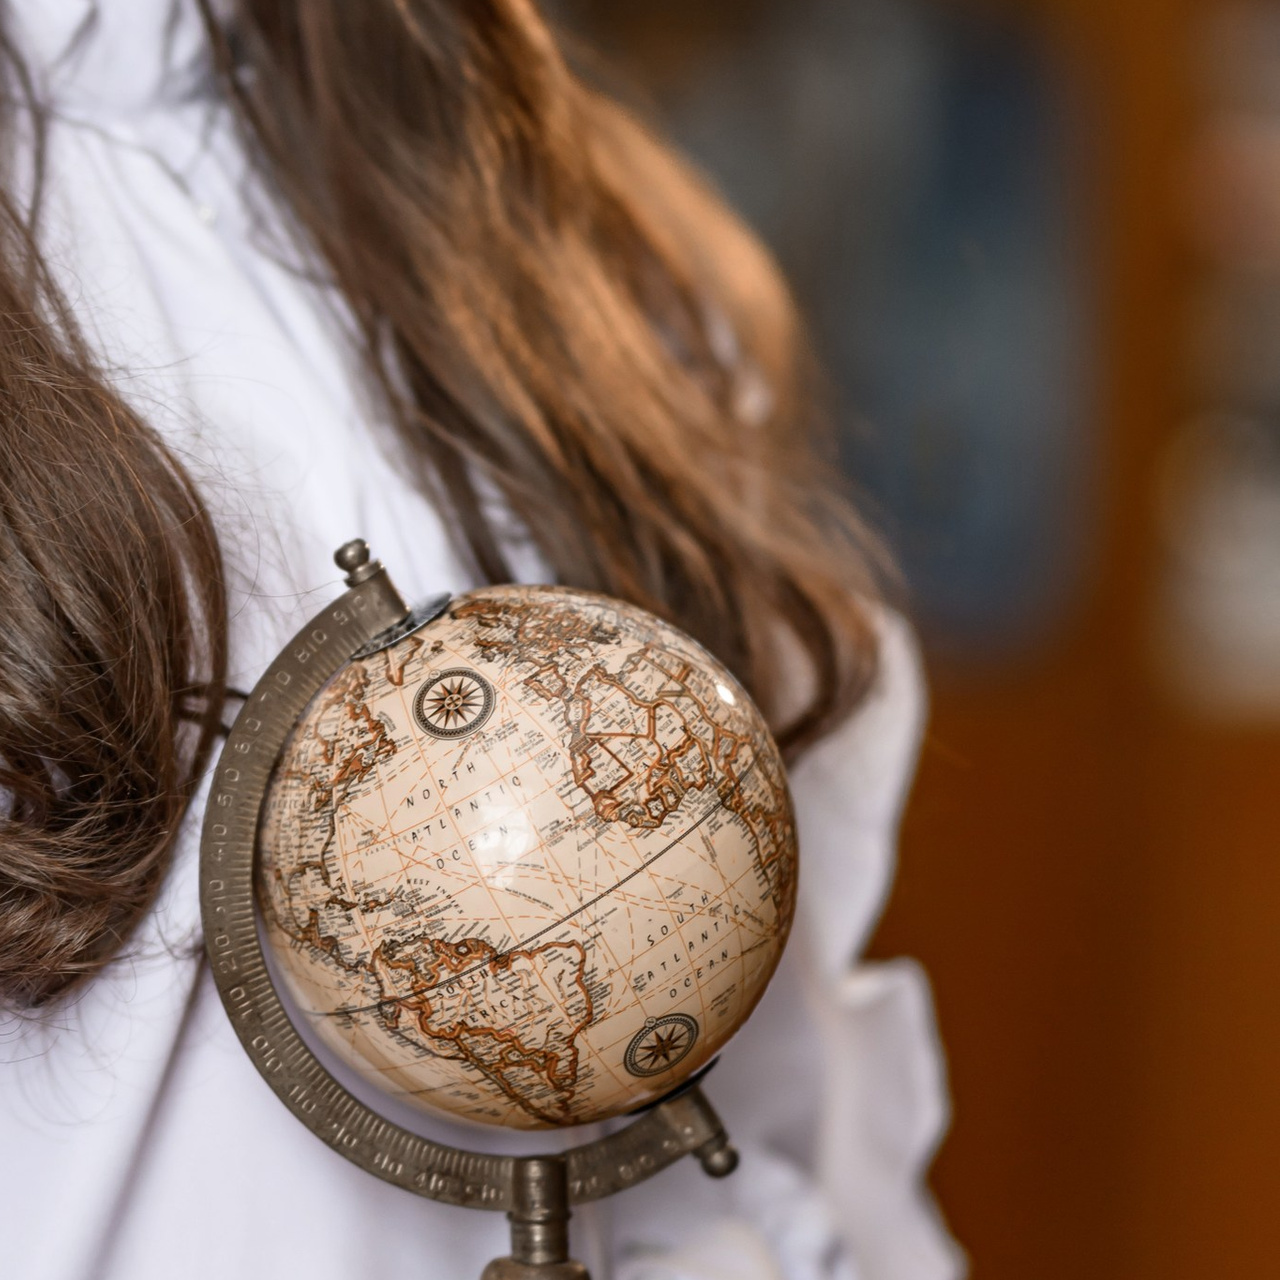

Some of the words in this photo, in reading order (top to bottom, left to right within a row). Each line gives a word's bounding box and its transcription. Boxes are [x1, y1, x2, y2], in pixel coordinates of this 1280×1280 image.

[406, 761, 476, 808] NORTH
[411, 775, 522, 843] ATLANTIC
[436, 824, 509, 870] OCEAN
[647, 893, 710, 947] SOUTH
[647, 904, 741, 982] ATLANTIC
[437, 967, 490, 1000] SOUTH
[668, 950, 728, 998] OCEAN
[447, 994, 521, 1033] AMERICA
